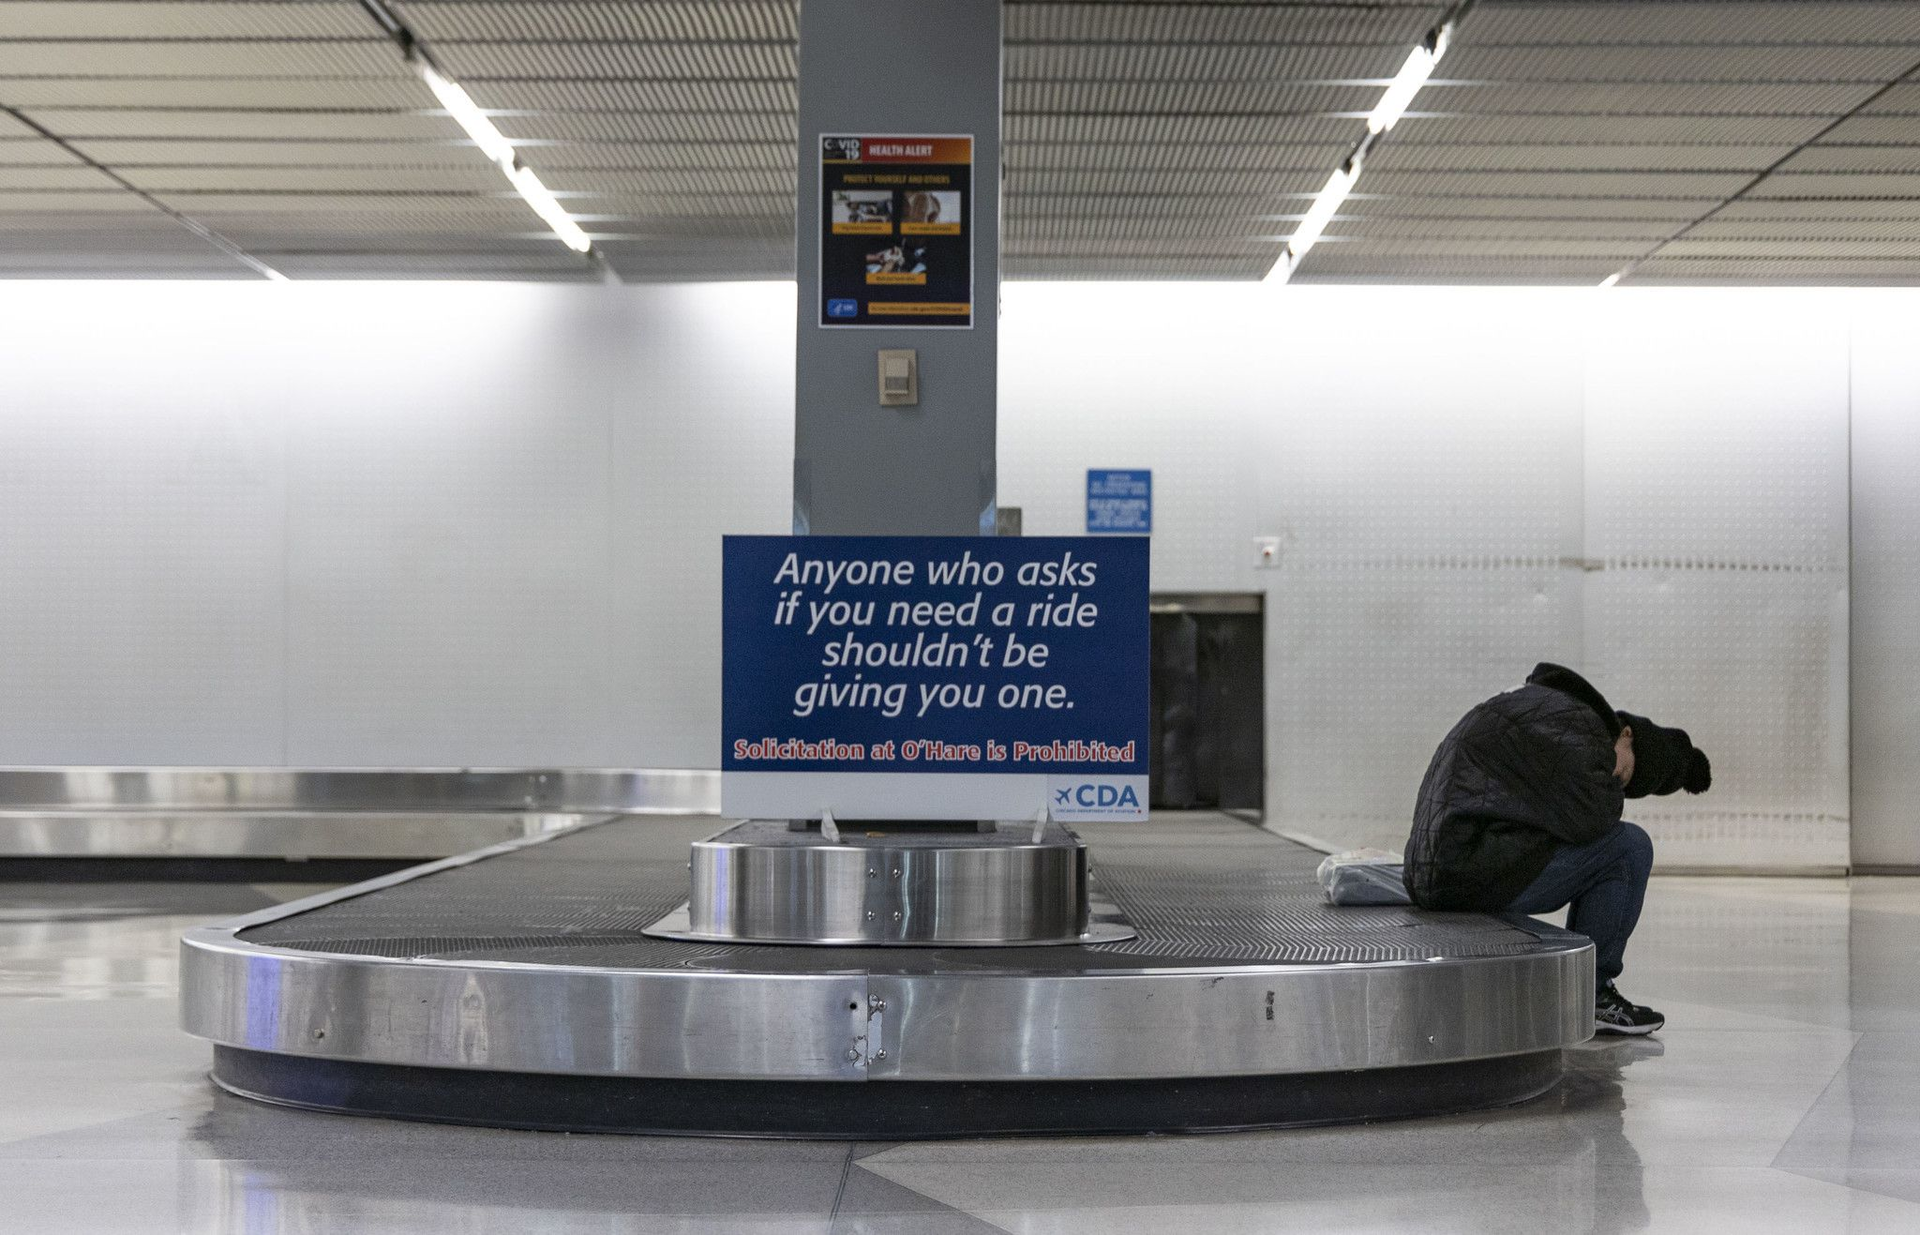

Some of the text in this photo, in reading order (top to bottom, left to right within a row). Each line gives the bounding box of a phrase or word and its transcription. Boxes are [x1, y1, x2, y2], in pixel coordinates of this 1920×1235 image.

[824, 139, 860, 150] CVID
[845, 149, 860, 160] 19
[868, 144, 933, 157] HEALTH ALERT
[773, 550, 1097, 594] Anyone who asks
[774, 591, 1098, 634] if you need a ride
[821, 632, 1049, 668] shouldn't be
[793, 674, 1075, 717] giving you one.
[734, 737, 1135, 762] Solicitation at O'Hare is Prohibited
[1076, 784, 1139, 807] CDA
